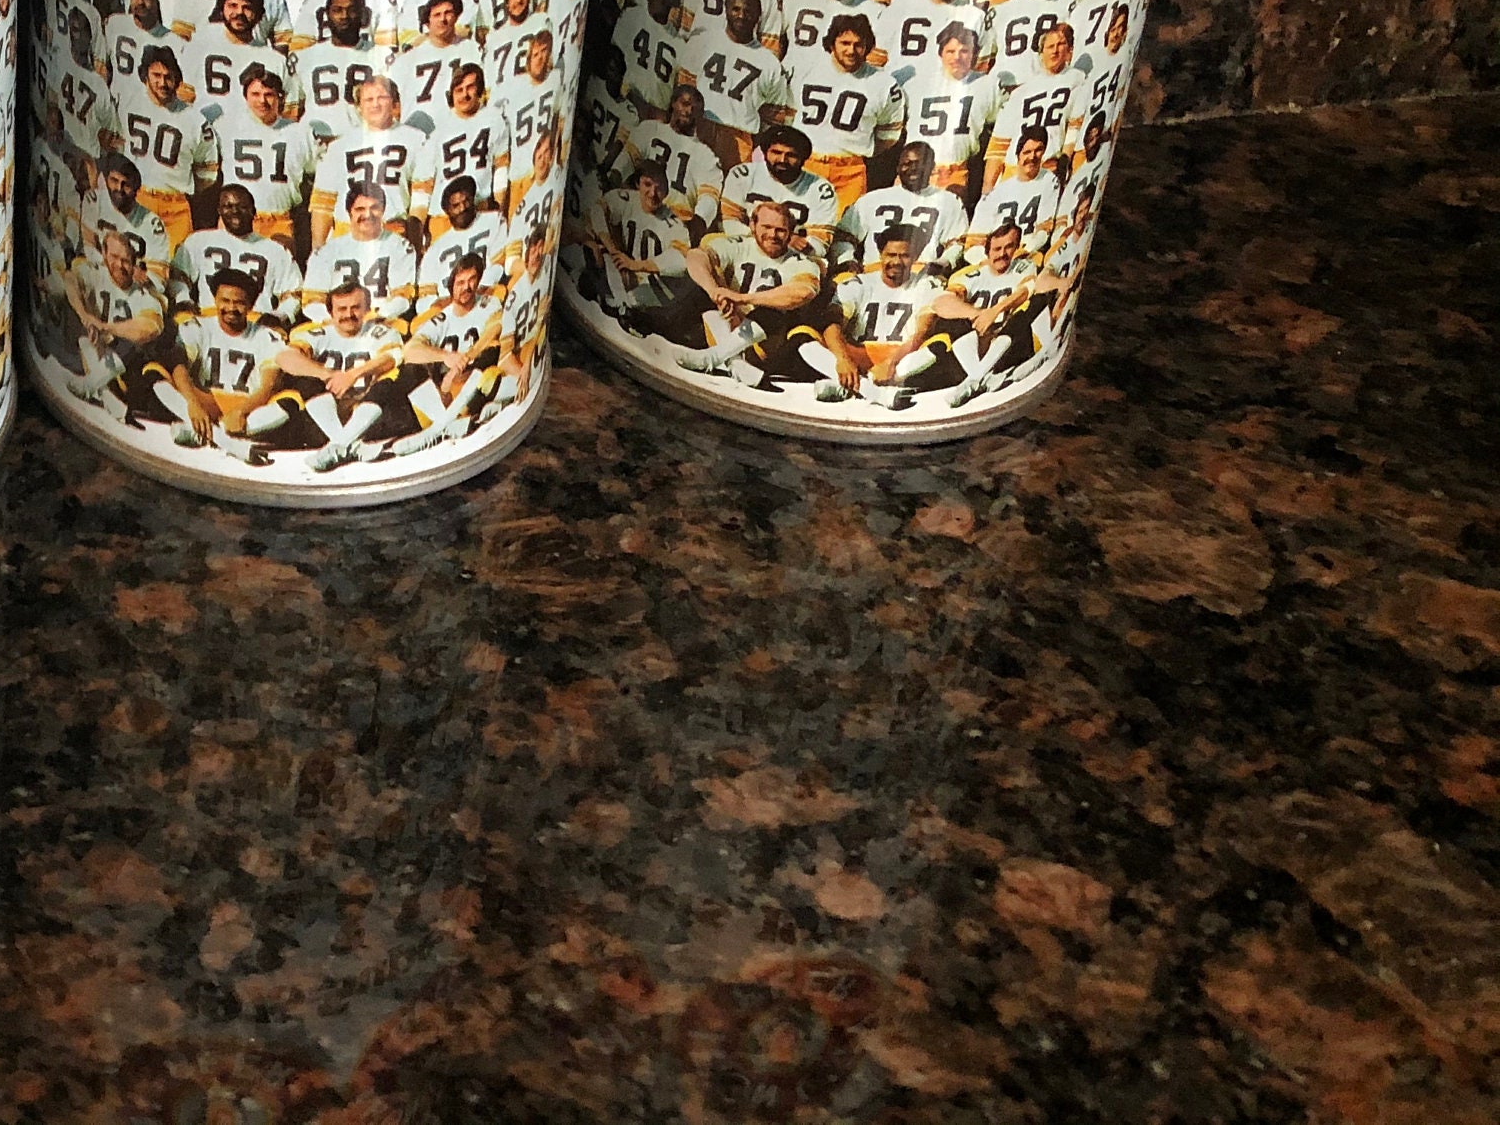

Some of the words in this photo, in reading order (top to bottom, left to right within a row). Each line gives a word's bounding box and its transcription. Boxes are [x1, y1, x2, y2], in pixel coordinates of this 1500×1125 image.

[633, 28, 676, 83] 46
[703, 52, 762, 101] 47
[60, 72, 97, 125] 47
[802, 83, 868, 132] 50
[1021, 88, 1071, 133] 52
[1090, 64, 1122, 116] 54
[919, 95, 974, 136] 51
[128, 113, 183, 168] 50
[234, 139, 288, 183] 51
[442, 127, 491, 180] 54
[346, 144, 407, 187] 52
[334, 256, 391, 298] 34
[859, 302, 914, 343] 17
[208, 348, 255, 393] 17
